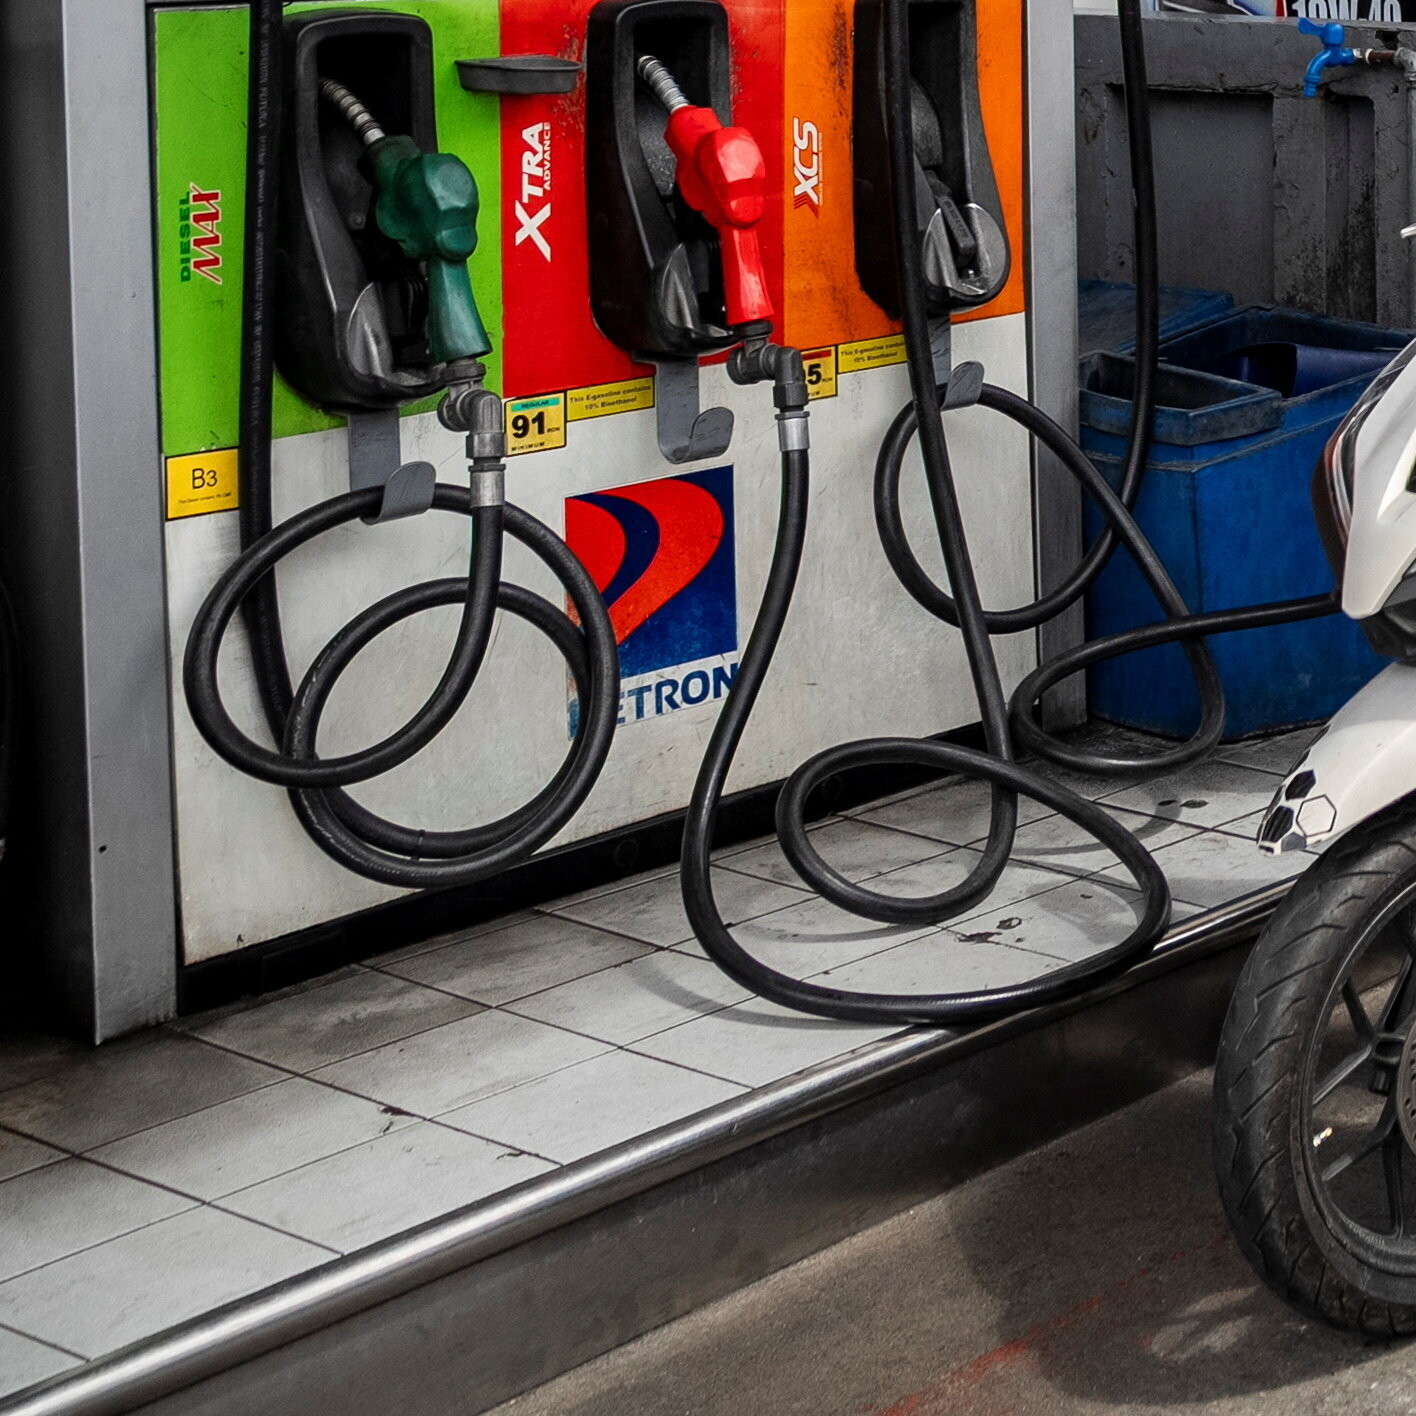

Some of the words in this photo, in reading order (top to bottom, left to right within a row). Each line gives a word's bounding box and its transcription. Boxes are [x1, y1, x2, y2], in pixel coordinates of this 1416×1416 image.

[543, 121, 552, 191] ADVANCE
[793, 116, 819, 206] XCS
[514, 121, 552, 264] XTRA
[180, 191, 191, 283] DIESEL
[190, 181, 222, 285] MAX
[807, 363, 823, 385] 5
[520, 400, 550, 409] REGULAR
[586, 390, 621, 401] E-gasoline
[622, 384, 651, 395] contains
[600, 396, 637, 408] Bioethanol
[511, 411, 546, 439] 91
[191, 467, 218, 490] B3
